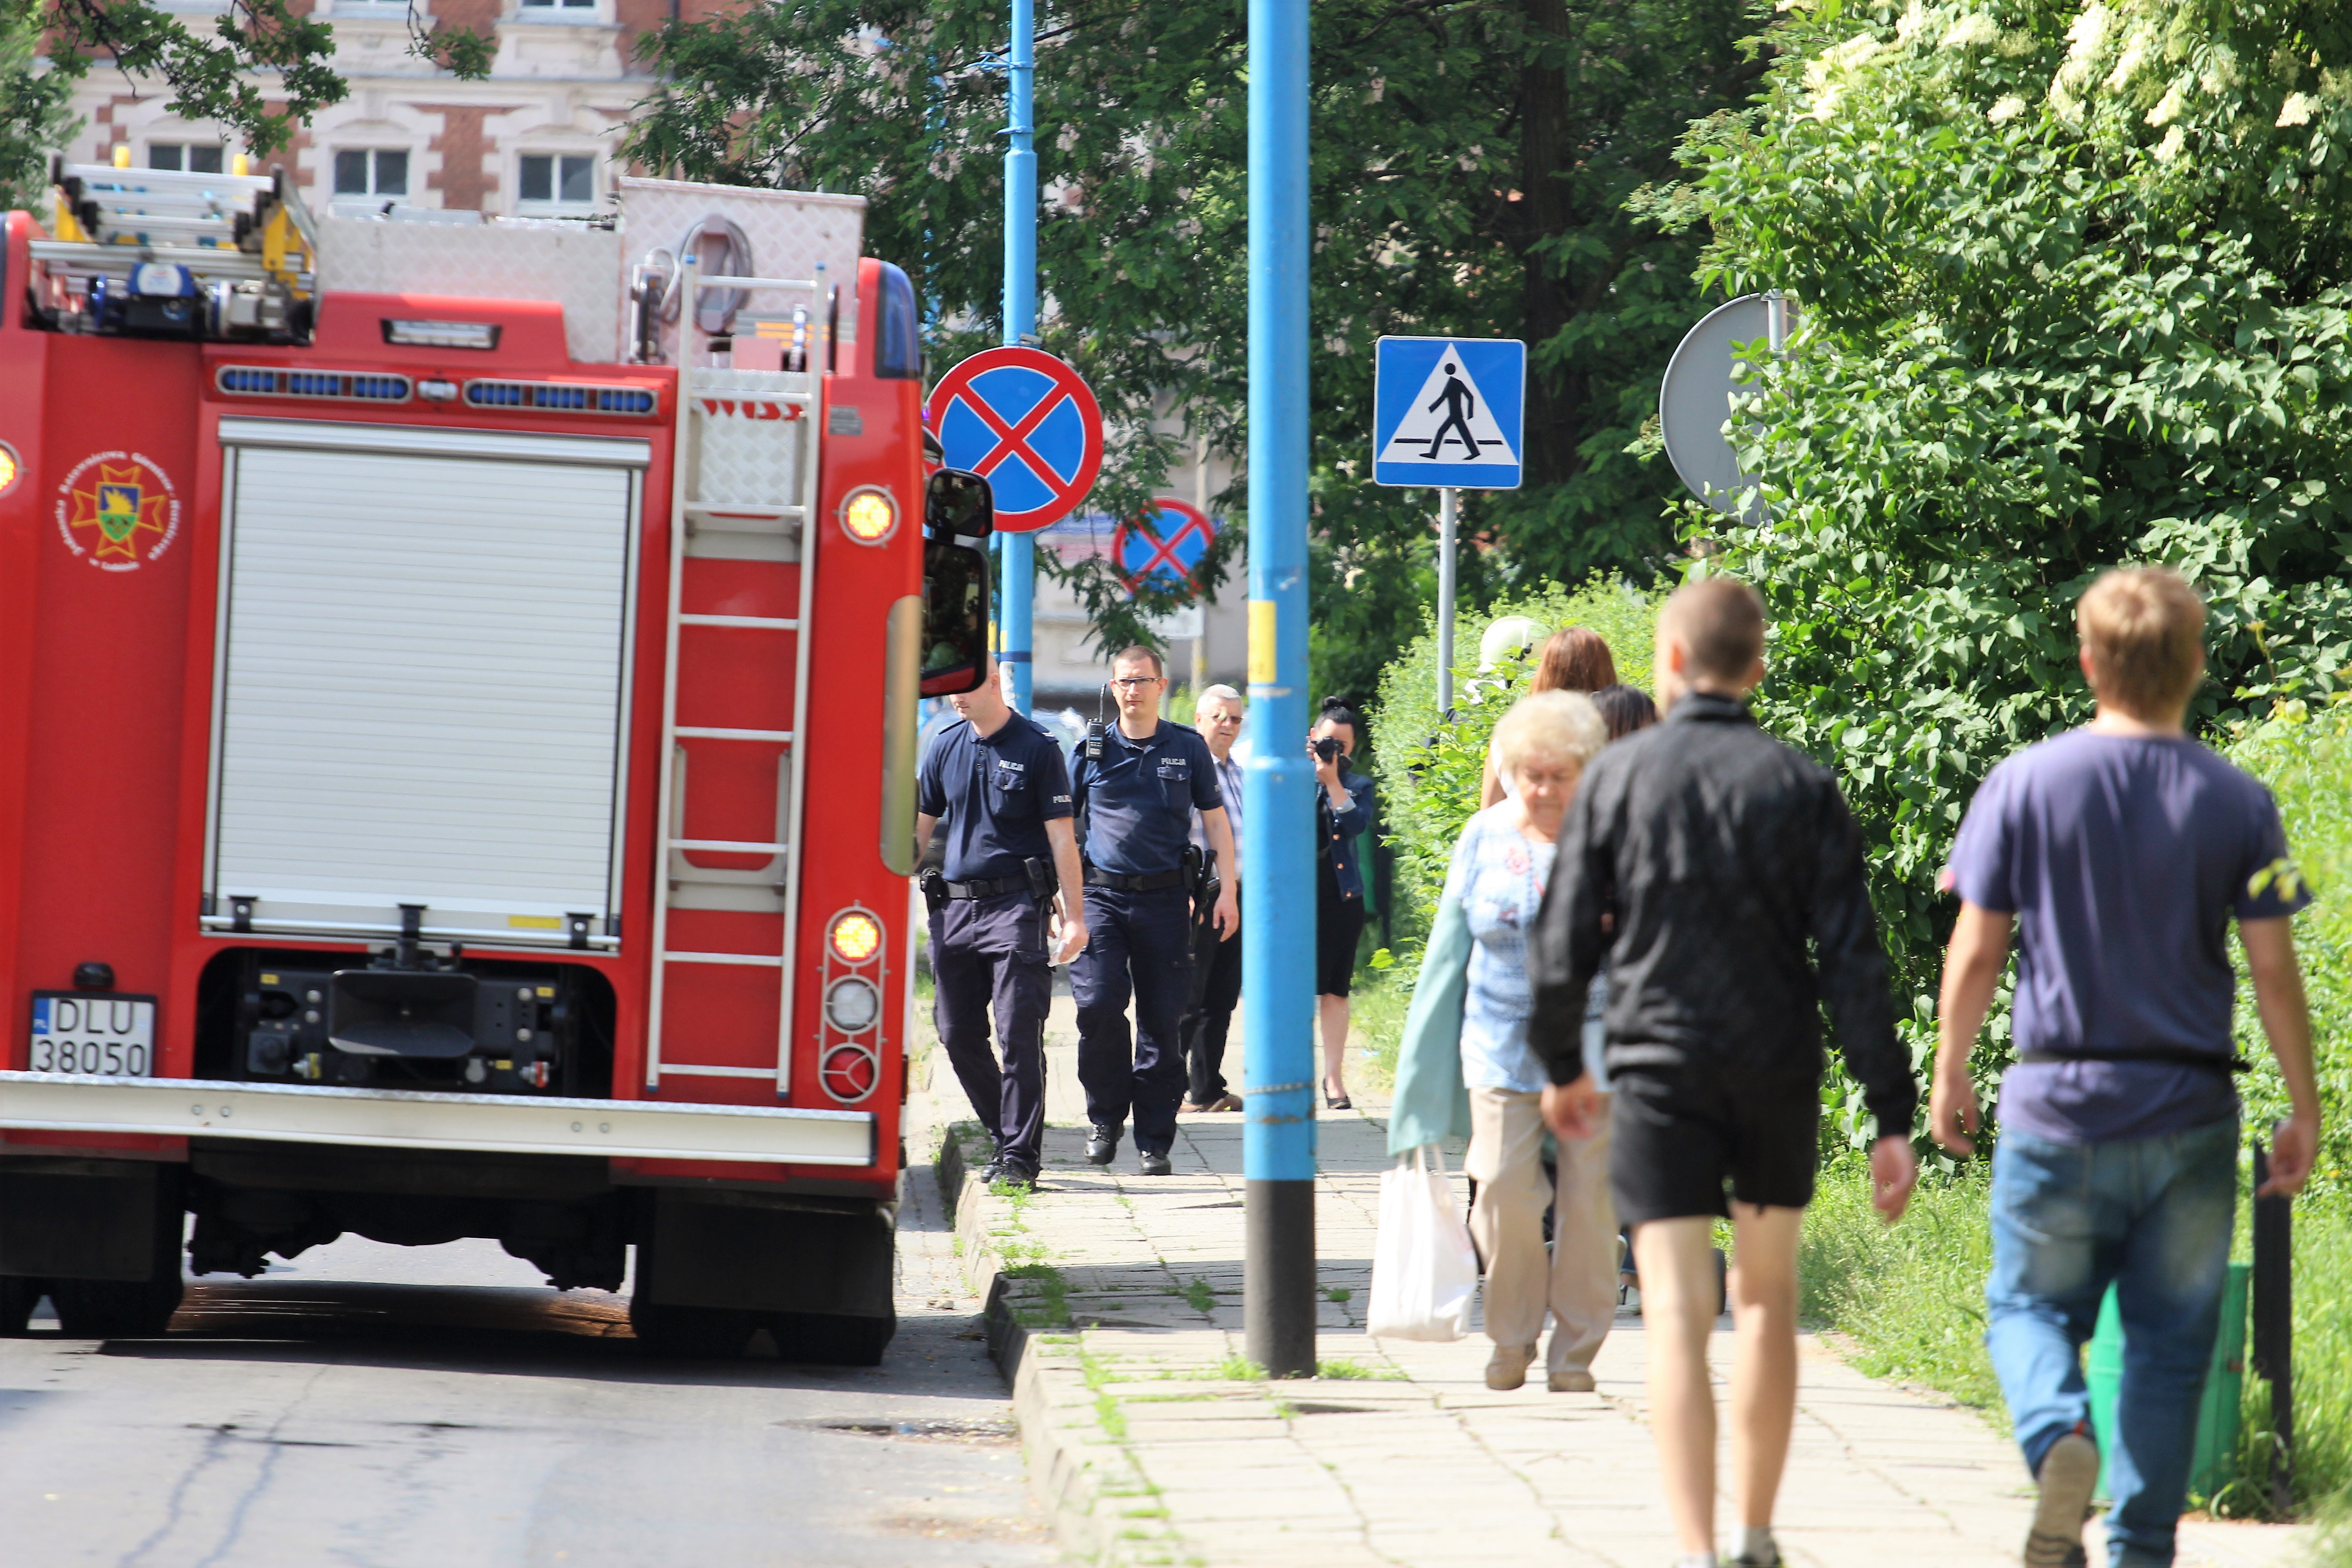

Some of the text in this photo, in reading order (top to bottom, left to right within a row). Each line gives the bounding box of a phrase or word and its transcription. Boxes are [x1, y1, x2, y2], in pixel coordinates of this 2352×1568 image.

[999, 760, 1024, 772] POLICJA
[1161, 758, 1186, 766] POLICJA
[56, 998, 133, 1034] DLU
[36, 1039, 144, 1075] 38050
